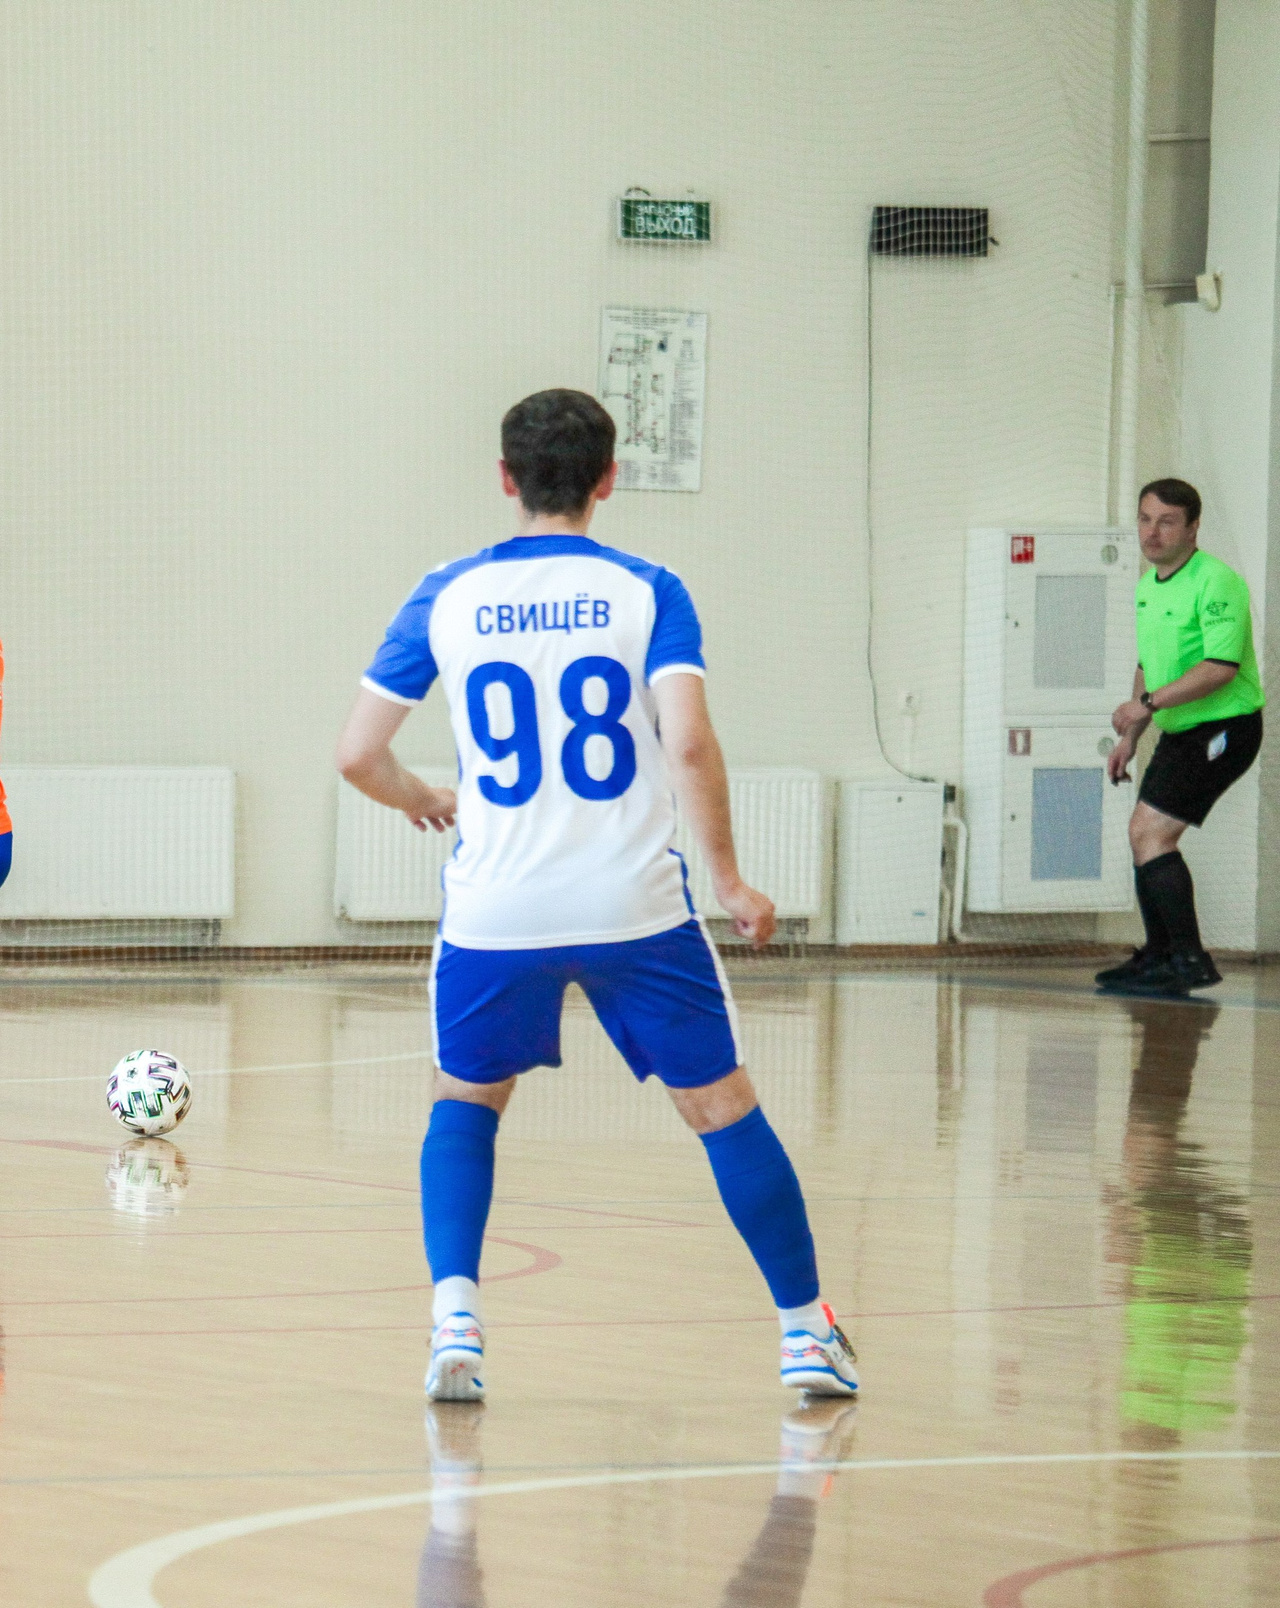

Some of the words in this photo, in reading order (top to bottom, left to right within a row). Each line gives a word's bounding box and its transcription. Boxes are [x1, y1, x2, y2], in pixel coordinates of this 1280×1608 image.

[635, 216, 697, 239] ВЫХОД
[476, 593, 610, 636] СВИЩЁВ
[466, 655, 637, 809] 98
